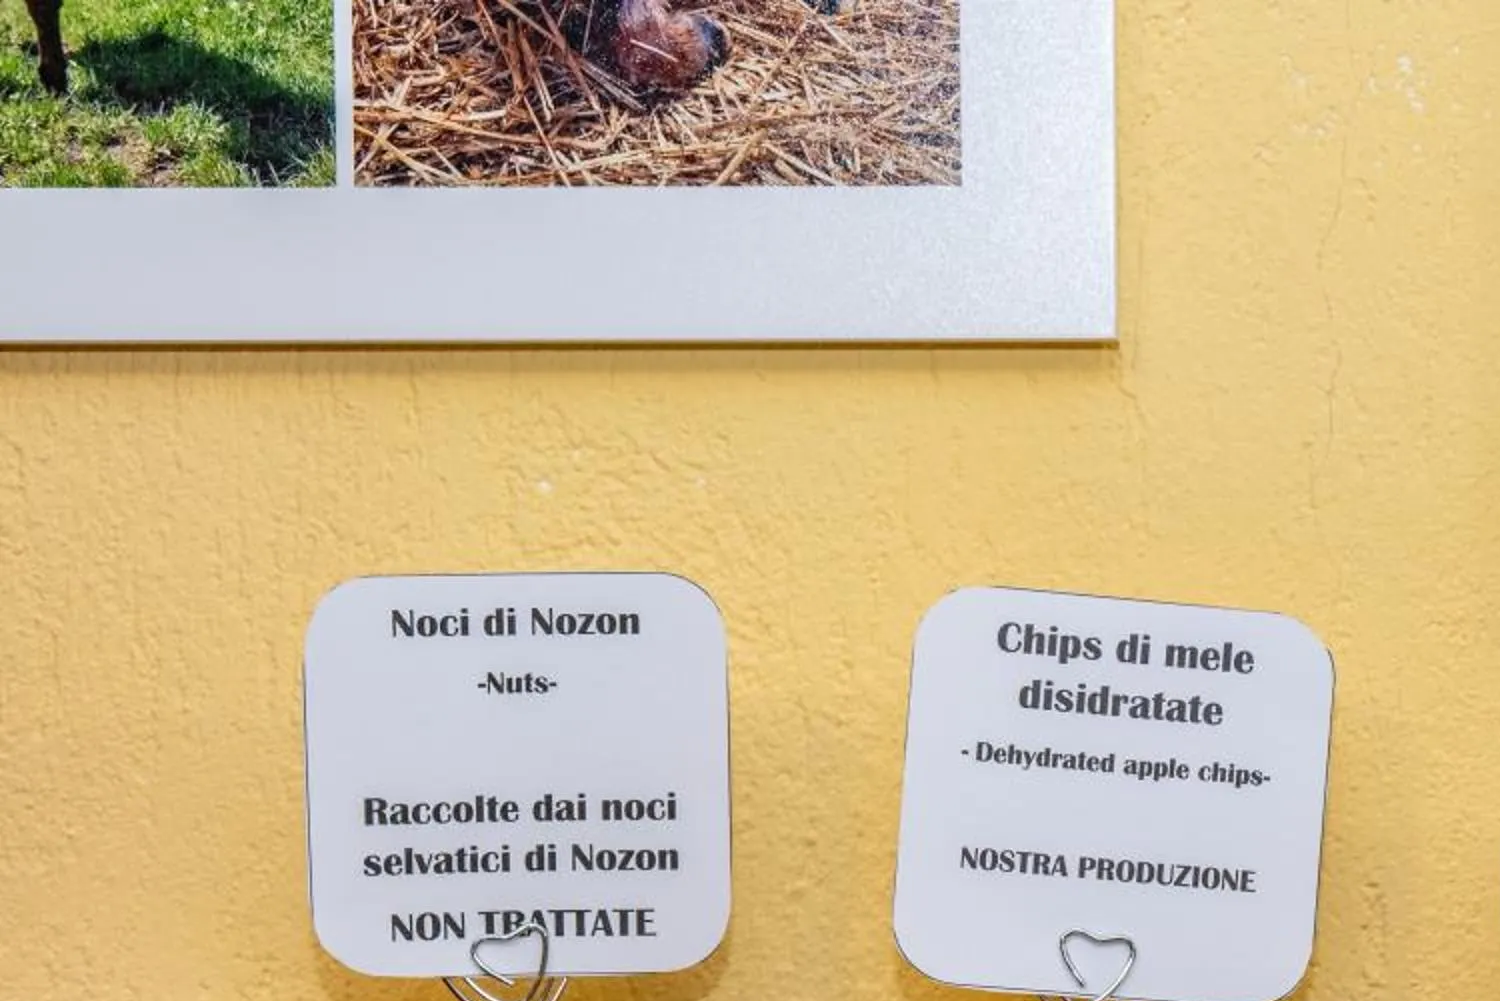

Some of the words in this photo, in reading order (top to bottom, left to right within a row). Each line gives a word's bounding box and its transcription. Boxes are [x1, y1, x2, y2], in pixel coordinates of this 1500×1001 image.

[391, 607, 469, 638] Noci
[483, 607, 517, 637] di
[531, 607, 640, 636] Nozon
[997, 622, 1102, 665] Chips
[1116, 633, 1151, 665] di
[1165, 642, 1255, 675] mele
[477, 671, 558, 694] -Nuts-
[1018, 679, 1223, 726] disidratate
[975, 741, 1115, 773] Dehydrated
[1123, 758, 1190, 782] apple
[1197, 762, 1271, 789] chips-
[363, 795, 520, 827] Raccolte
[532, 792, 587, 822] dai
[601, 791, 677, 821] noci
[363, 844, 511, 877] selvatici
[524, 843, 557, 873] di
[571, 843, 679, 871] Nozon
[960, 847, 1069, 877] NOSTRA
[1078, 856, 1256, 893] PRODUZIONE
[391, 911, 466, 942] NON
[478, 908, 656, 937] TRATTATE
